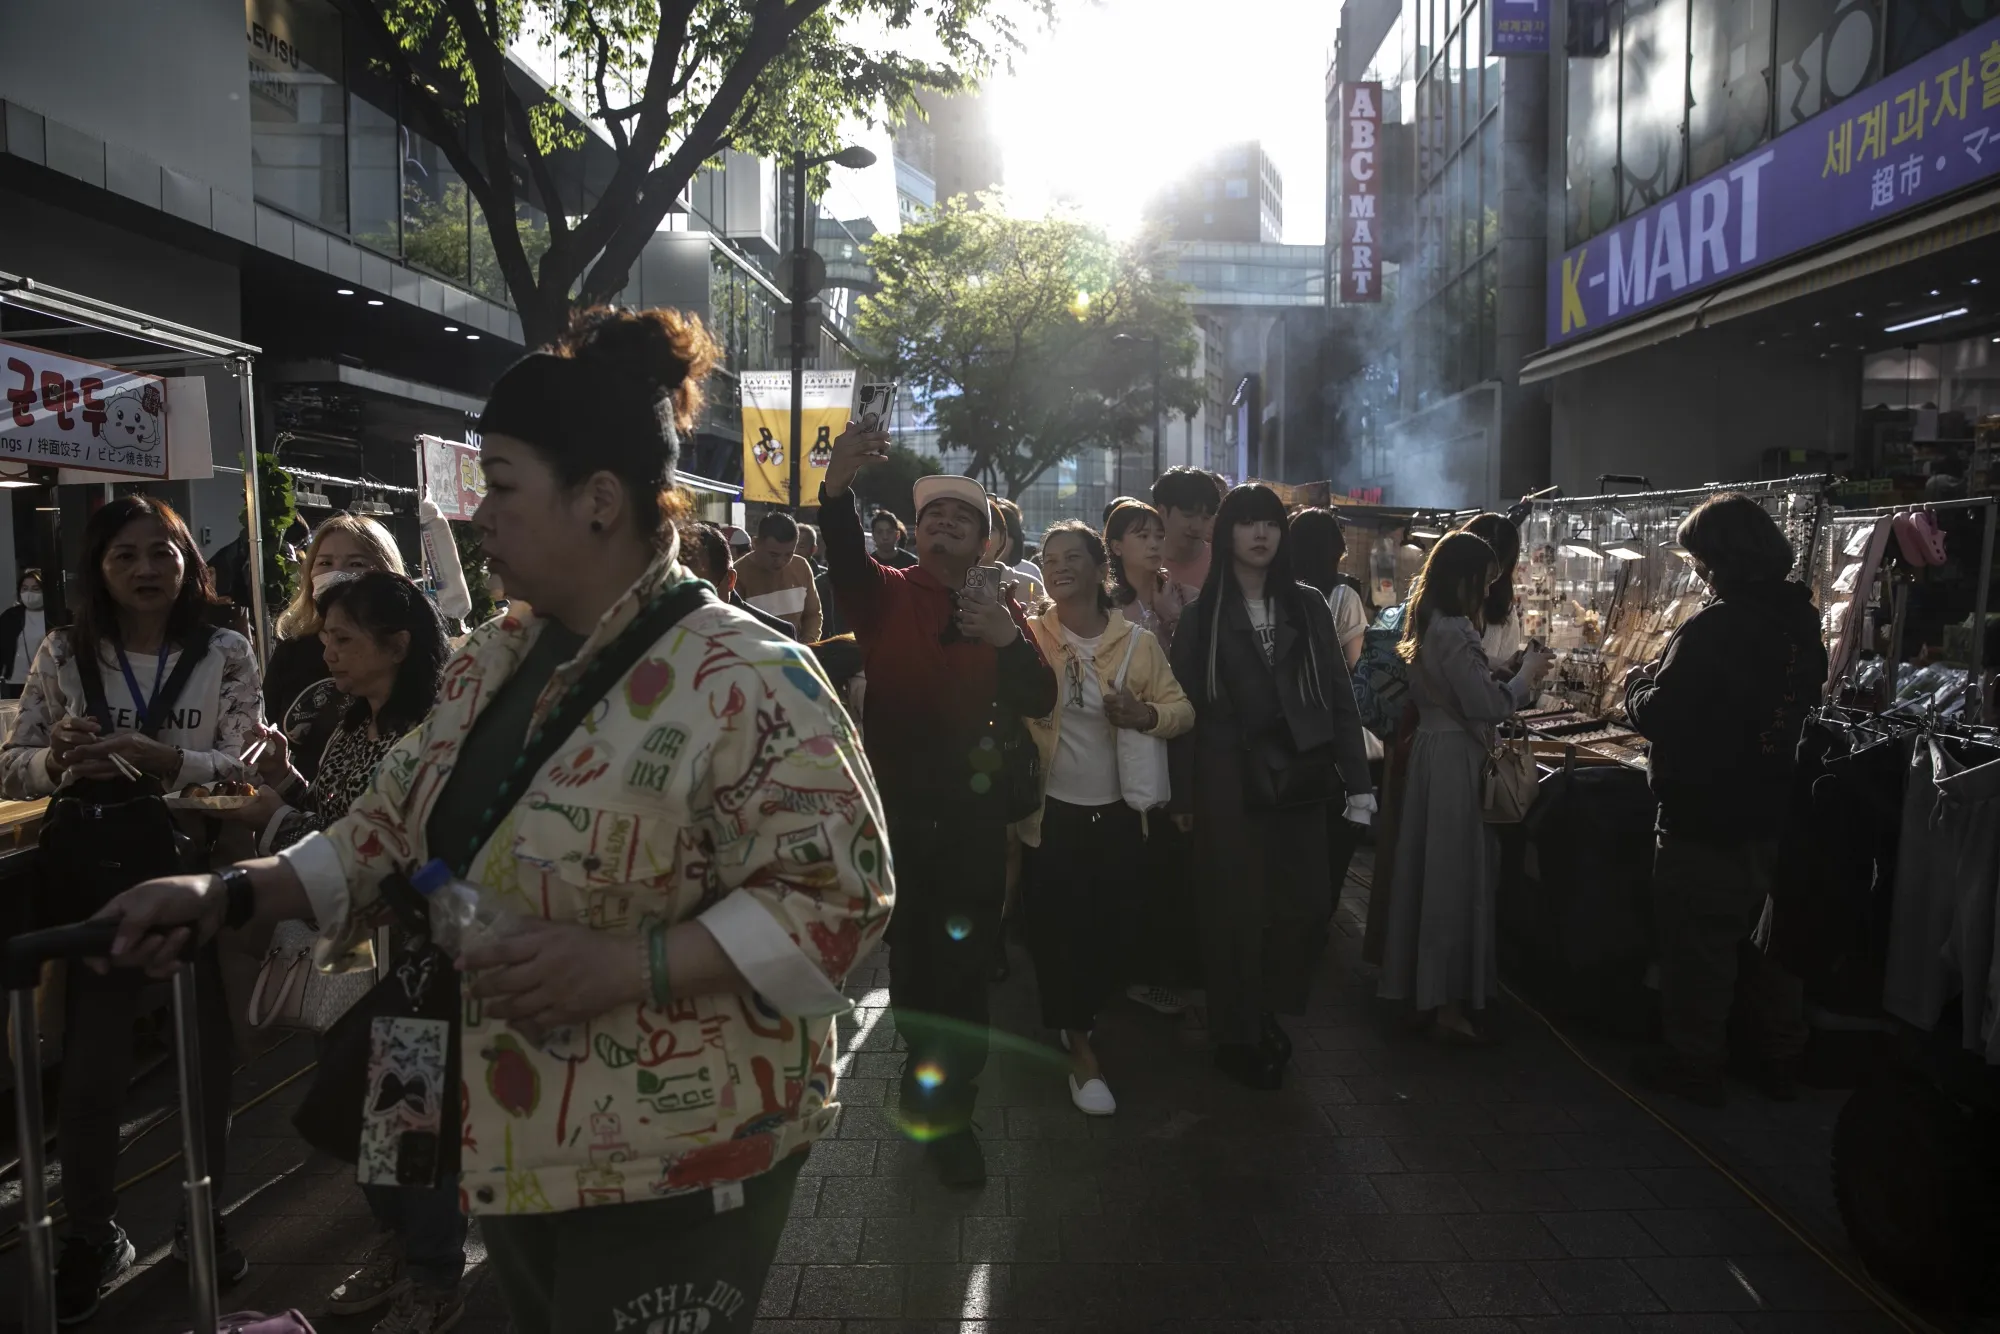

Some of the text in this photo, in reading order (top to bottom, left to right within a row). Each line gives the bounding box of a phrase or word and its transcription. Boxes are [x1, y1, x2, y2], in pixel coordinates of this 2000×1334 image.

[1561, 150, 1775, 334] K-MART
[7, 357, 107, 437] 군만두
[37, 437, 81, 458] 拌面饺子
